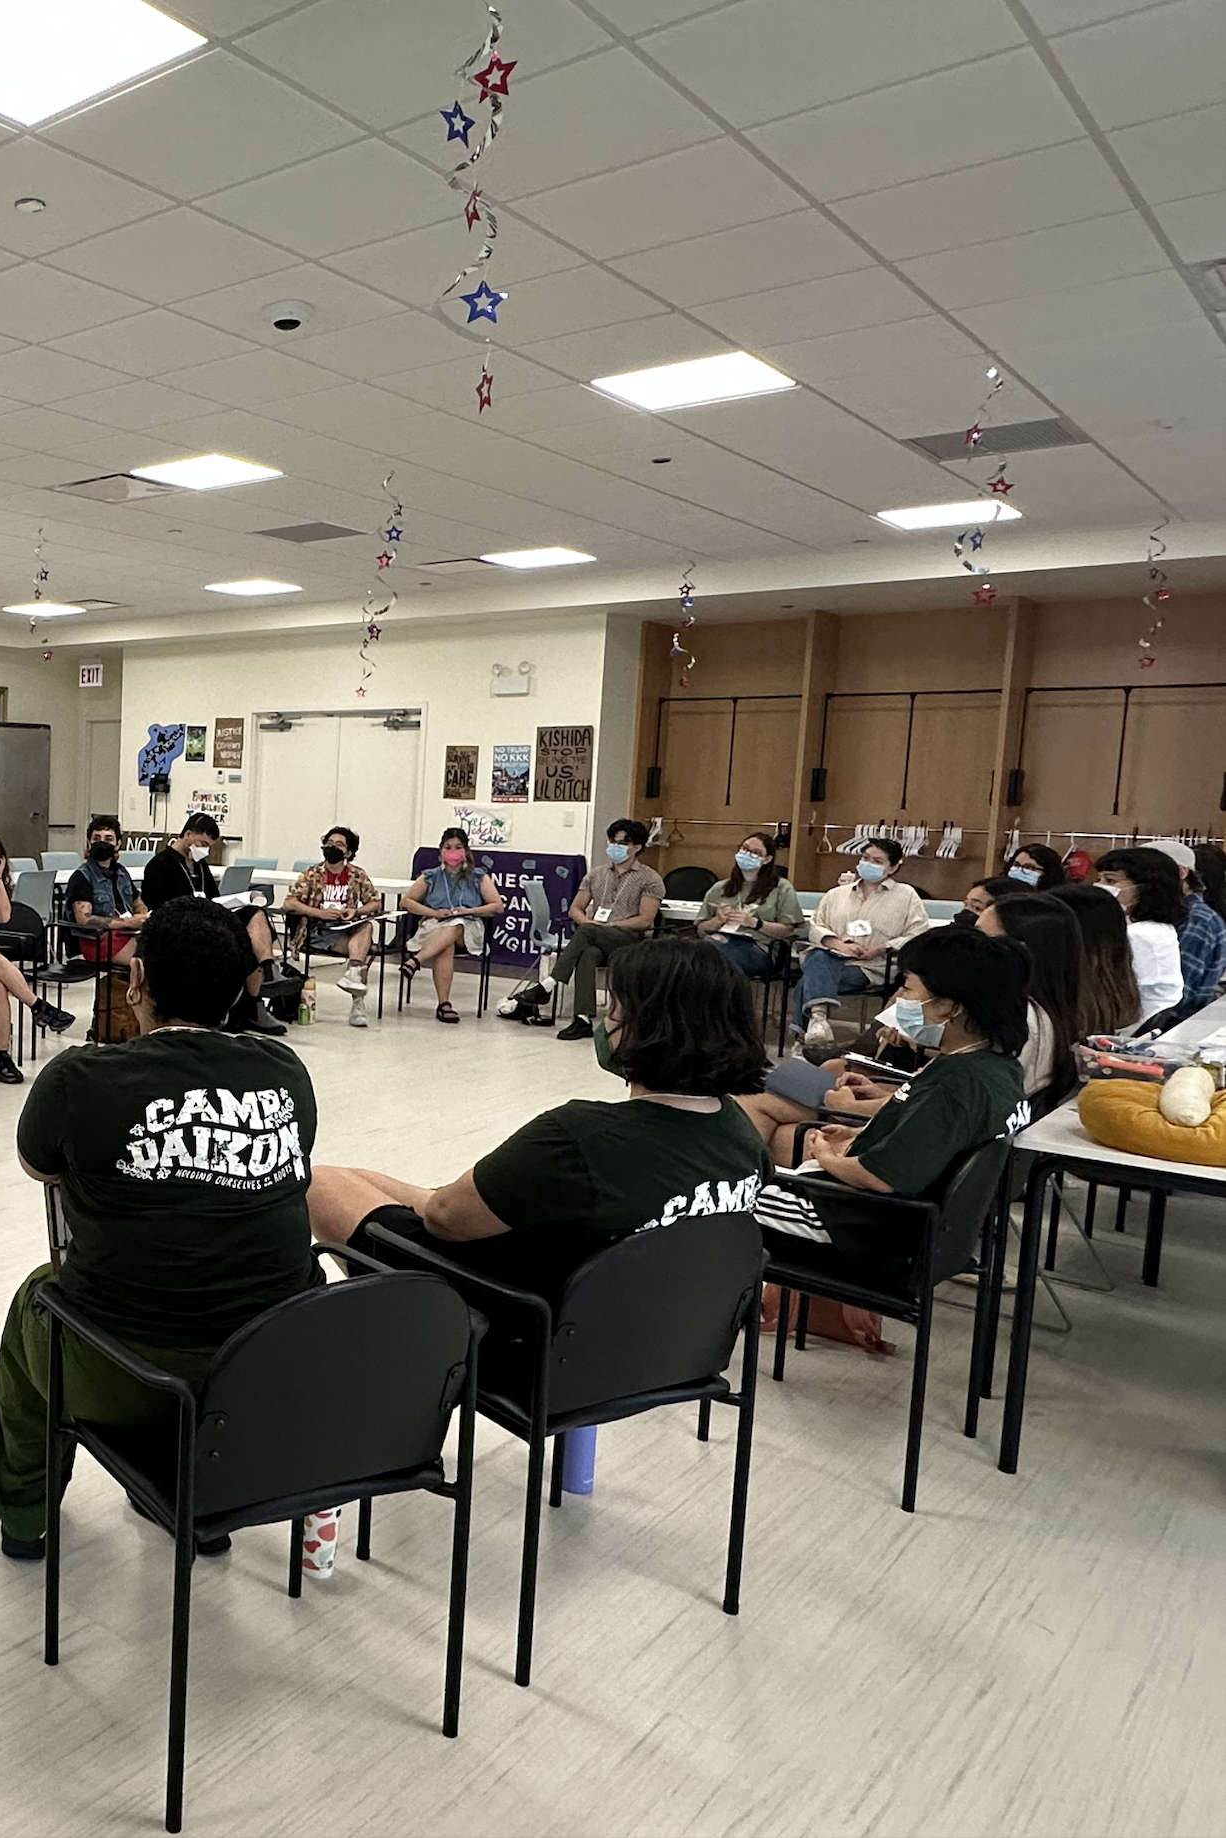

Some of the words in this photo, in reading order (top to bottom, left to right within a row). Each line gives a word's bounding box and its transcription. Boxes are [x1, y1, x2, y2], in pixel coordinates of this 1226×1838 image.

[81, 667, 100, 684] EXIT
[215, 726, 243, 738] JUSTICE
[539, 728, 591, 748] KISHIDA
[494, 746, 506, 754] NO
[494, 753, 508, 762] NO
[510, 753, 529, 762] KKK
[540, 747, 587, 756] STOP
[537, 757, 568, 766] BEING
[570, 756, 588, 765] THE
[446, 769, 475, 788] CARE
[534, 778, 551, 800] LIL
[554, 778, 590, 801] BITCH
[126, 837, 164, 853] NOT
[145, 1087, 282, 1134] CAMP
[126, 1121, 306, 1181] DAIKON
[174, 1168, 213, 1182] HOLDING
[215, 1175, 262, 1190] OURSELVES
[273, 1163, 293, 1184] ROOTS
